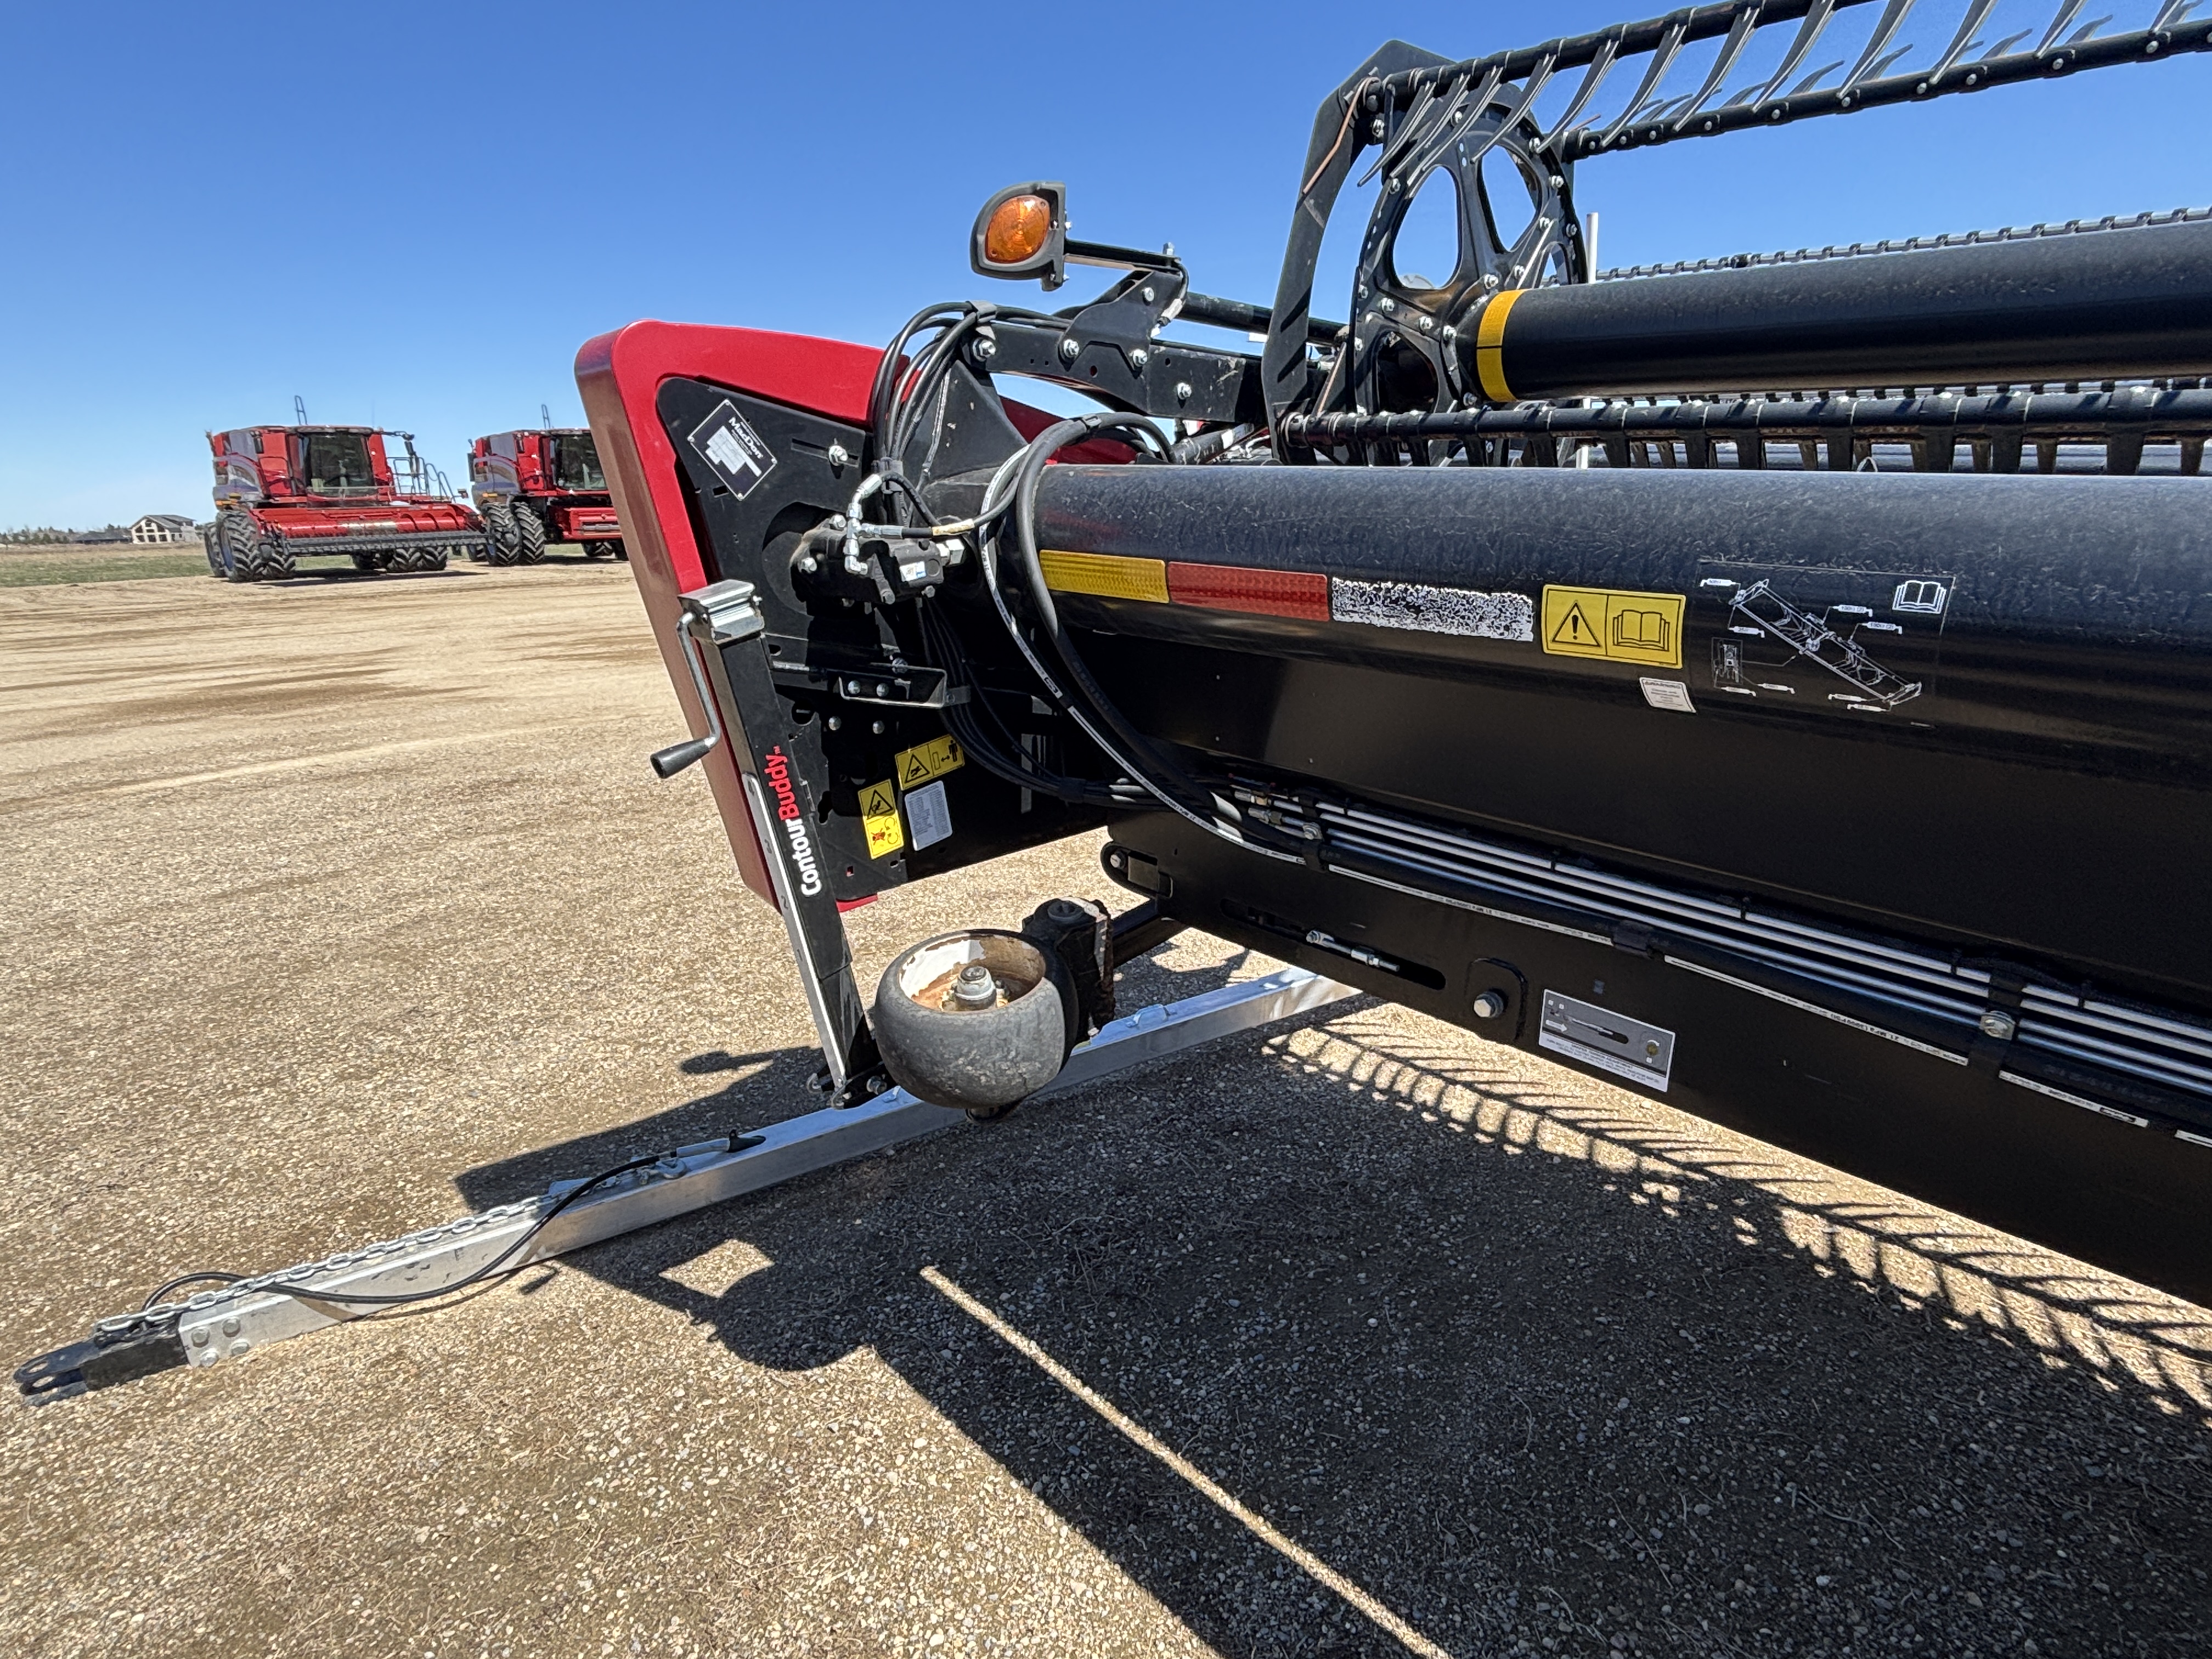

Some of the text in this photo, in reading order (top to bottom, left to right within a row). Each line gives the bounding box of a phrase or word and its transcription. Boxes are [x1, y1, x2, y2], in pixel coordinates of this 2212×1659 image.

[729, 417, 763, 459] MacDon
[764, 755, 821, 895] ContourBuddy
[780, 895, 789, 910] 2
